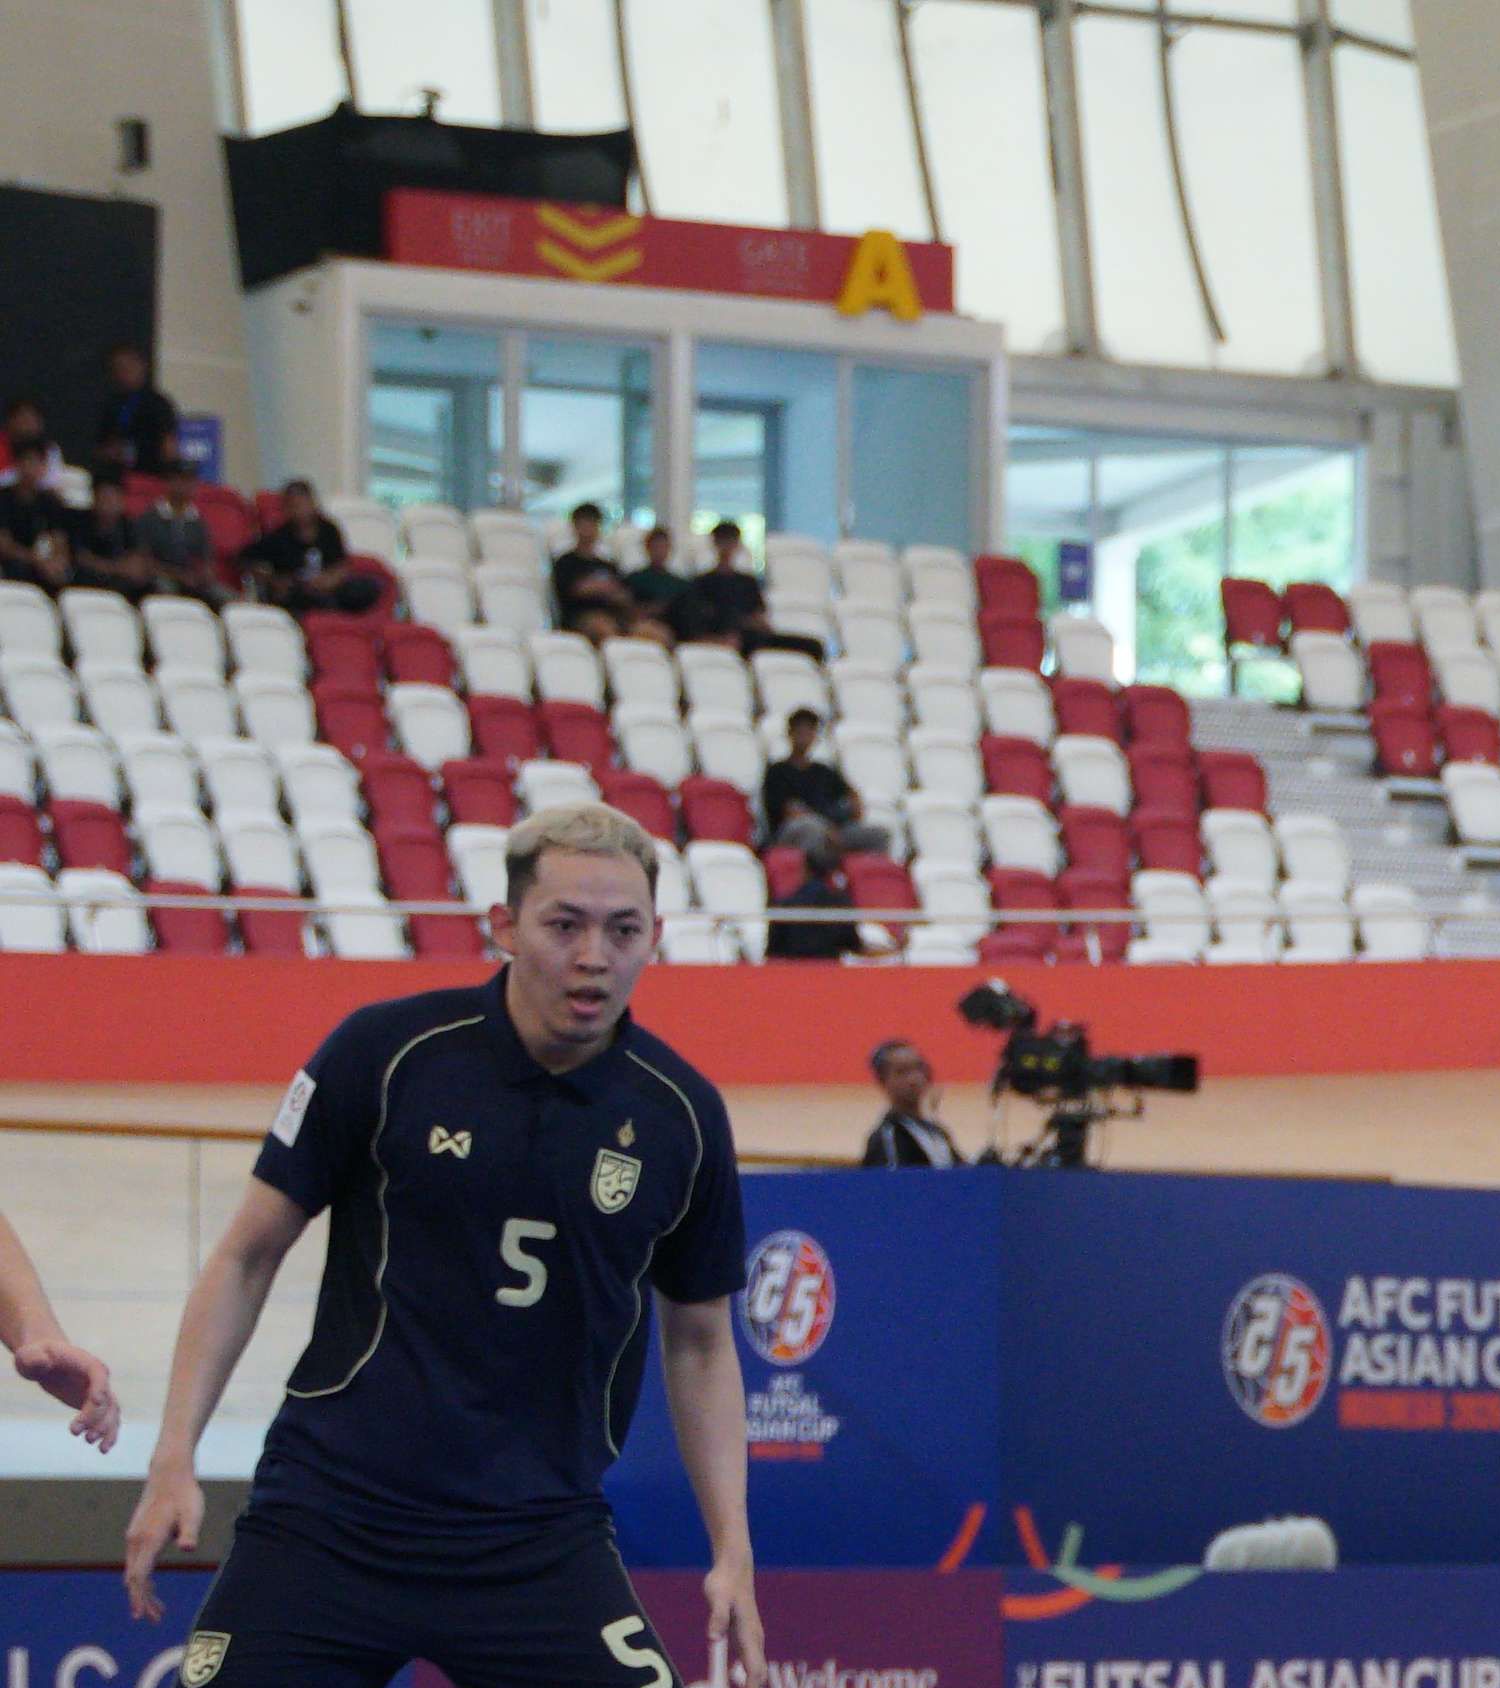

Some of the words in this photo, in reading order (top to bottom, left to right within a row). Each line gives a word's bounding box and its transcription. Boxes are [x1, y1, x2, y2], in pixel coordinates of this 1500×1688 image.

[838, 229, 922, 322] A
[496, 1218, 556, 1308] 5
[1338, 1275, 1431, 1330] AFC
[1339, 1333, 1478, 1387] ASIAN
